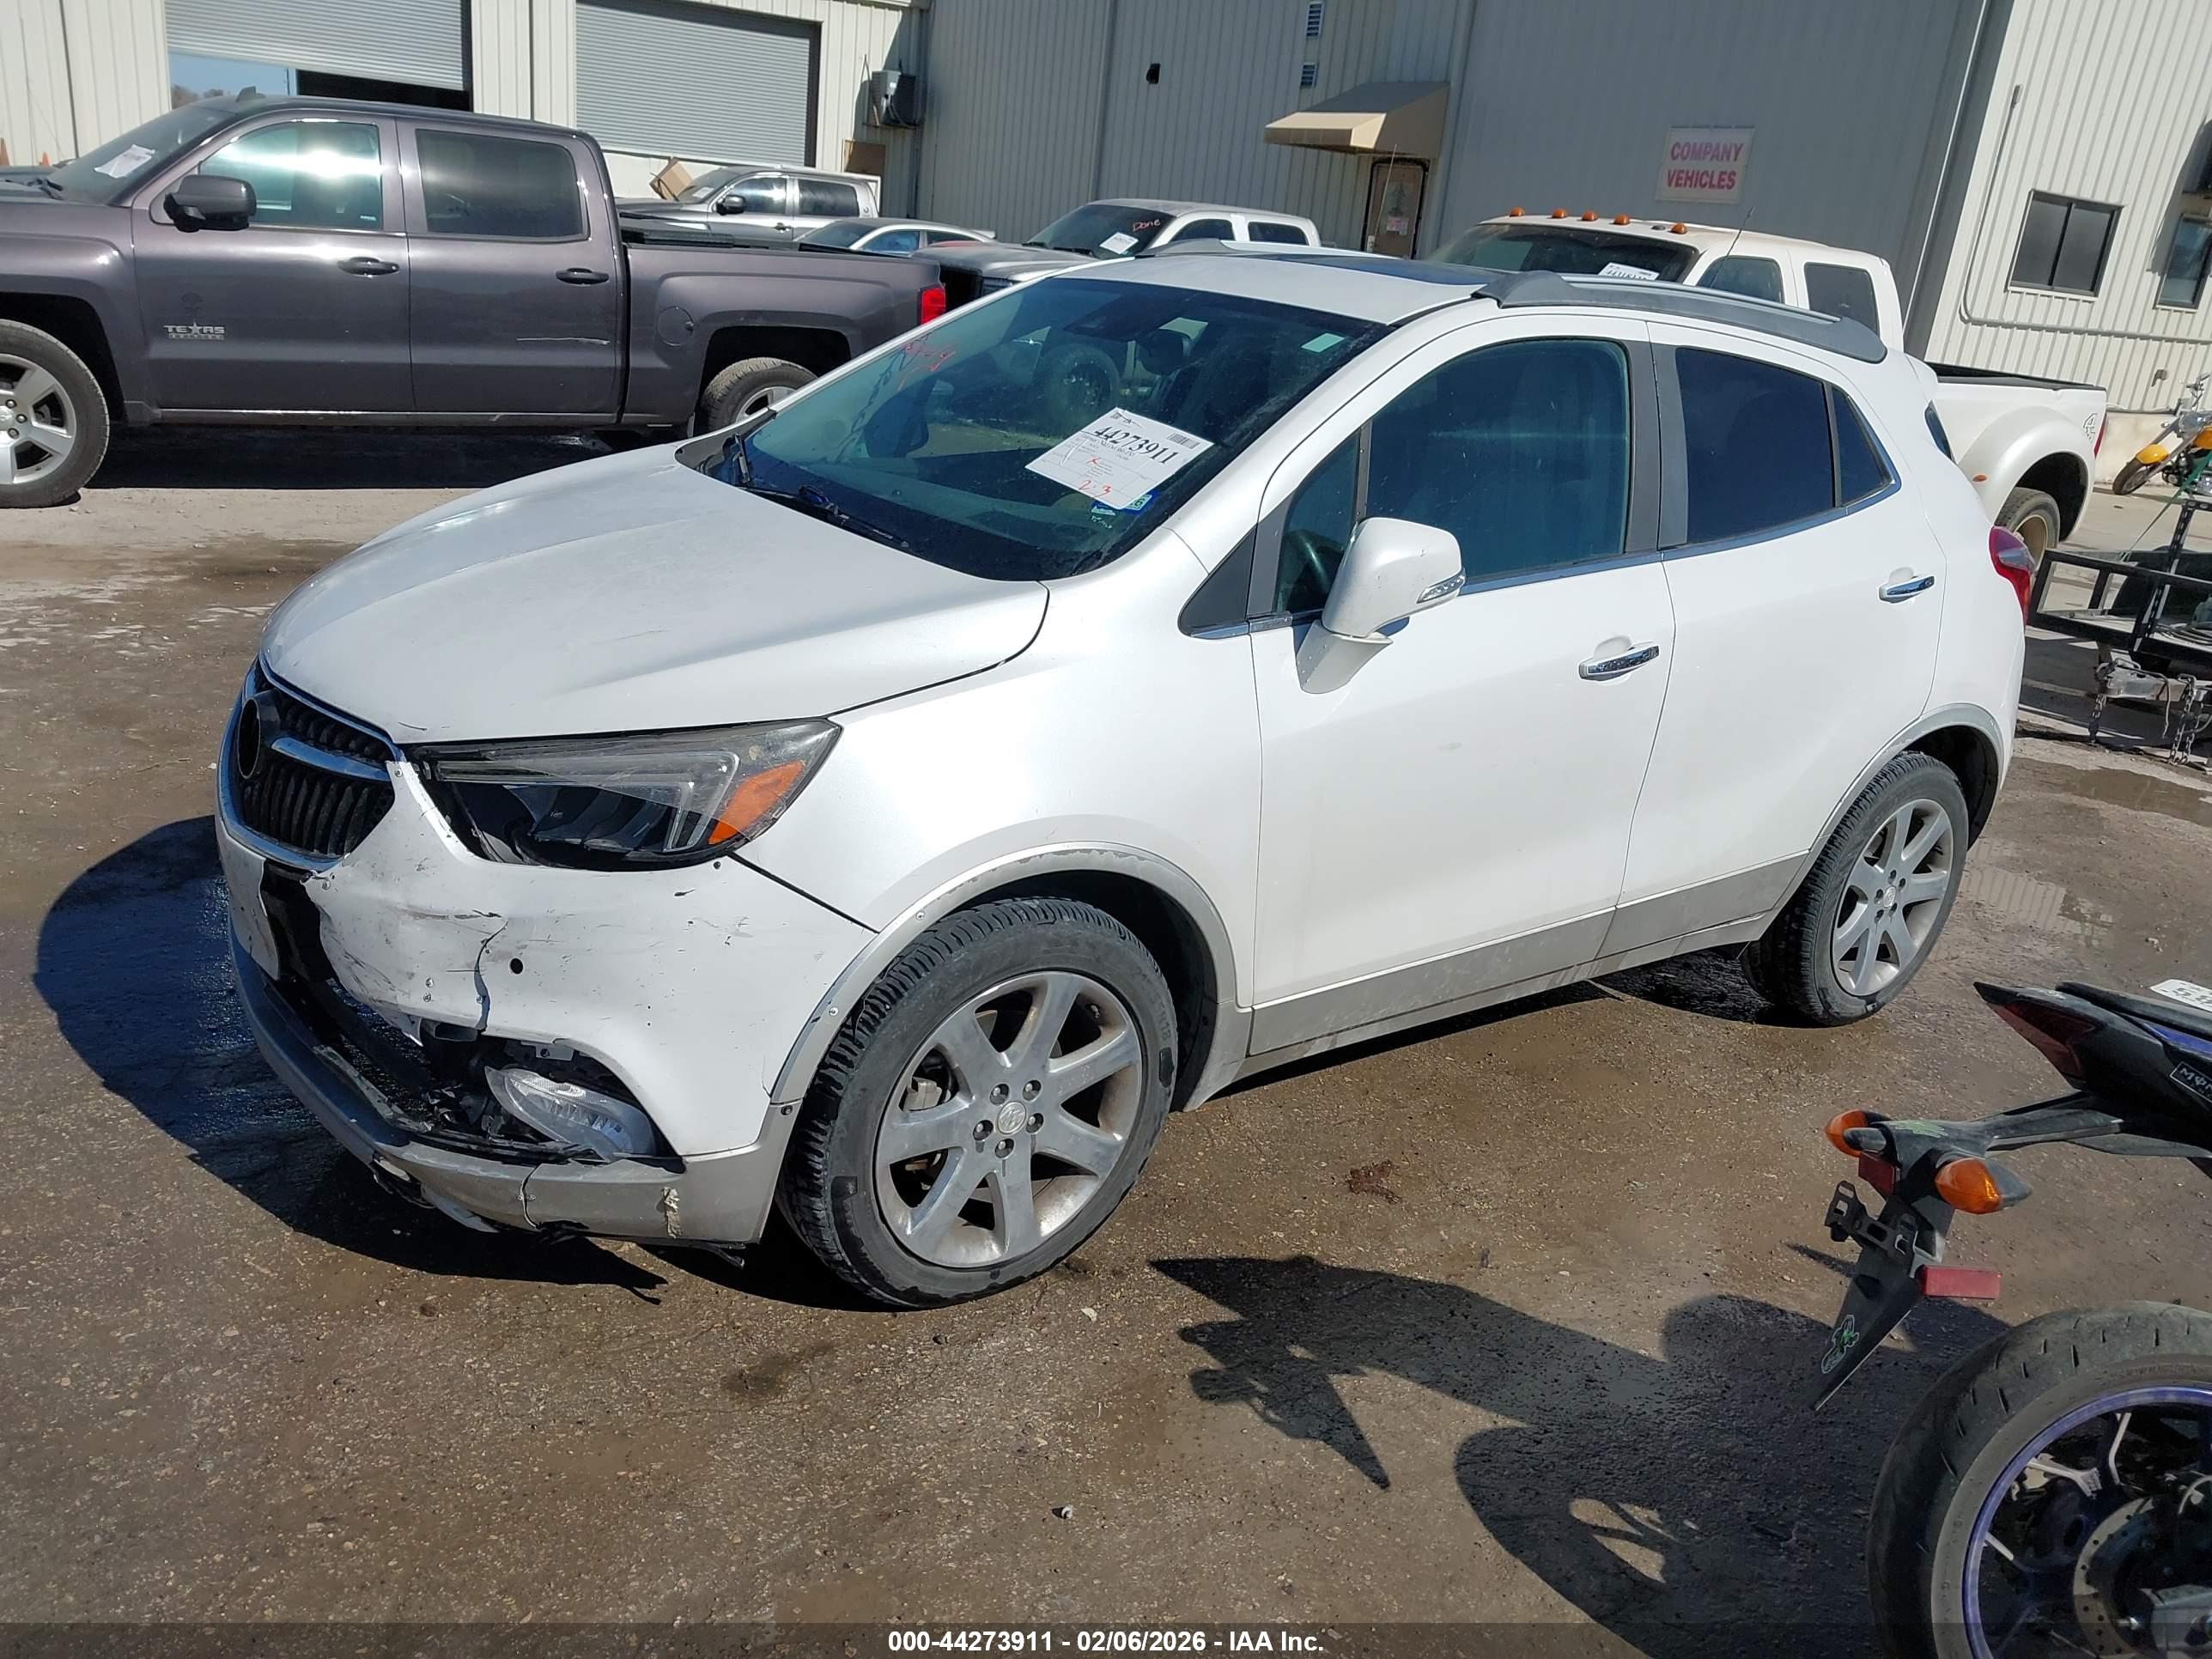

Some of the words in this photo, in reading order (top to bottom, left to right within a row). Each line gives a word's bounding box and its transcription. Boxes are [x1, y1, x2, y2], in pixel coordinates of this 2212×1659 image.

[1670, 142, 1744, 161] COMPANY
[1667, 169, 1736, 190] VEHICLES
[1133, 219, 1161, 233] Done
[1094, 426, 1180, 464] 44273911
